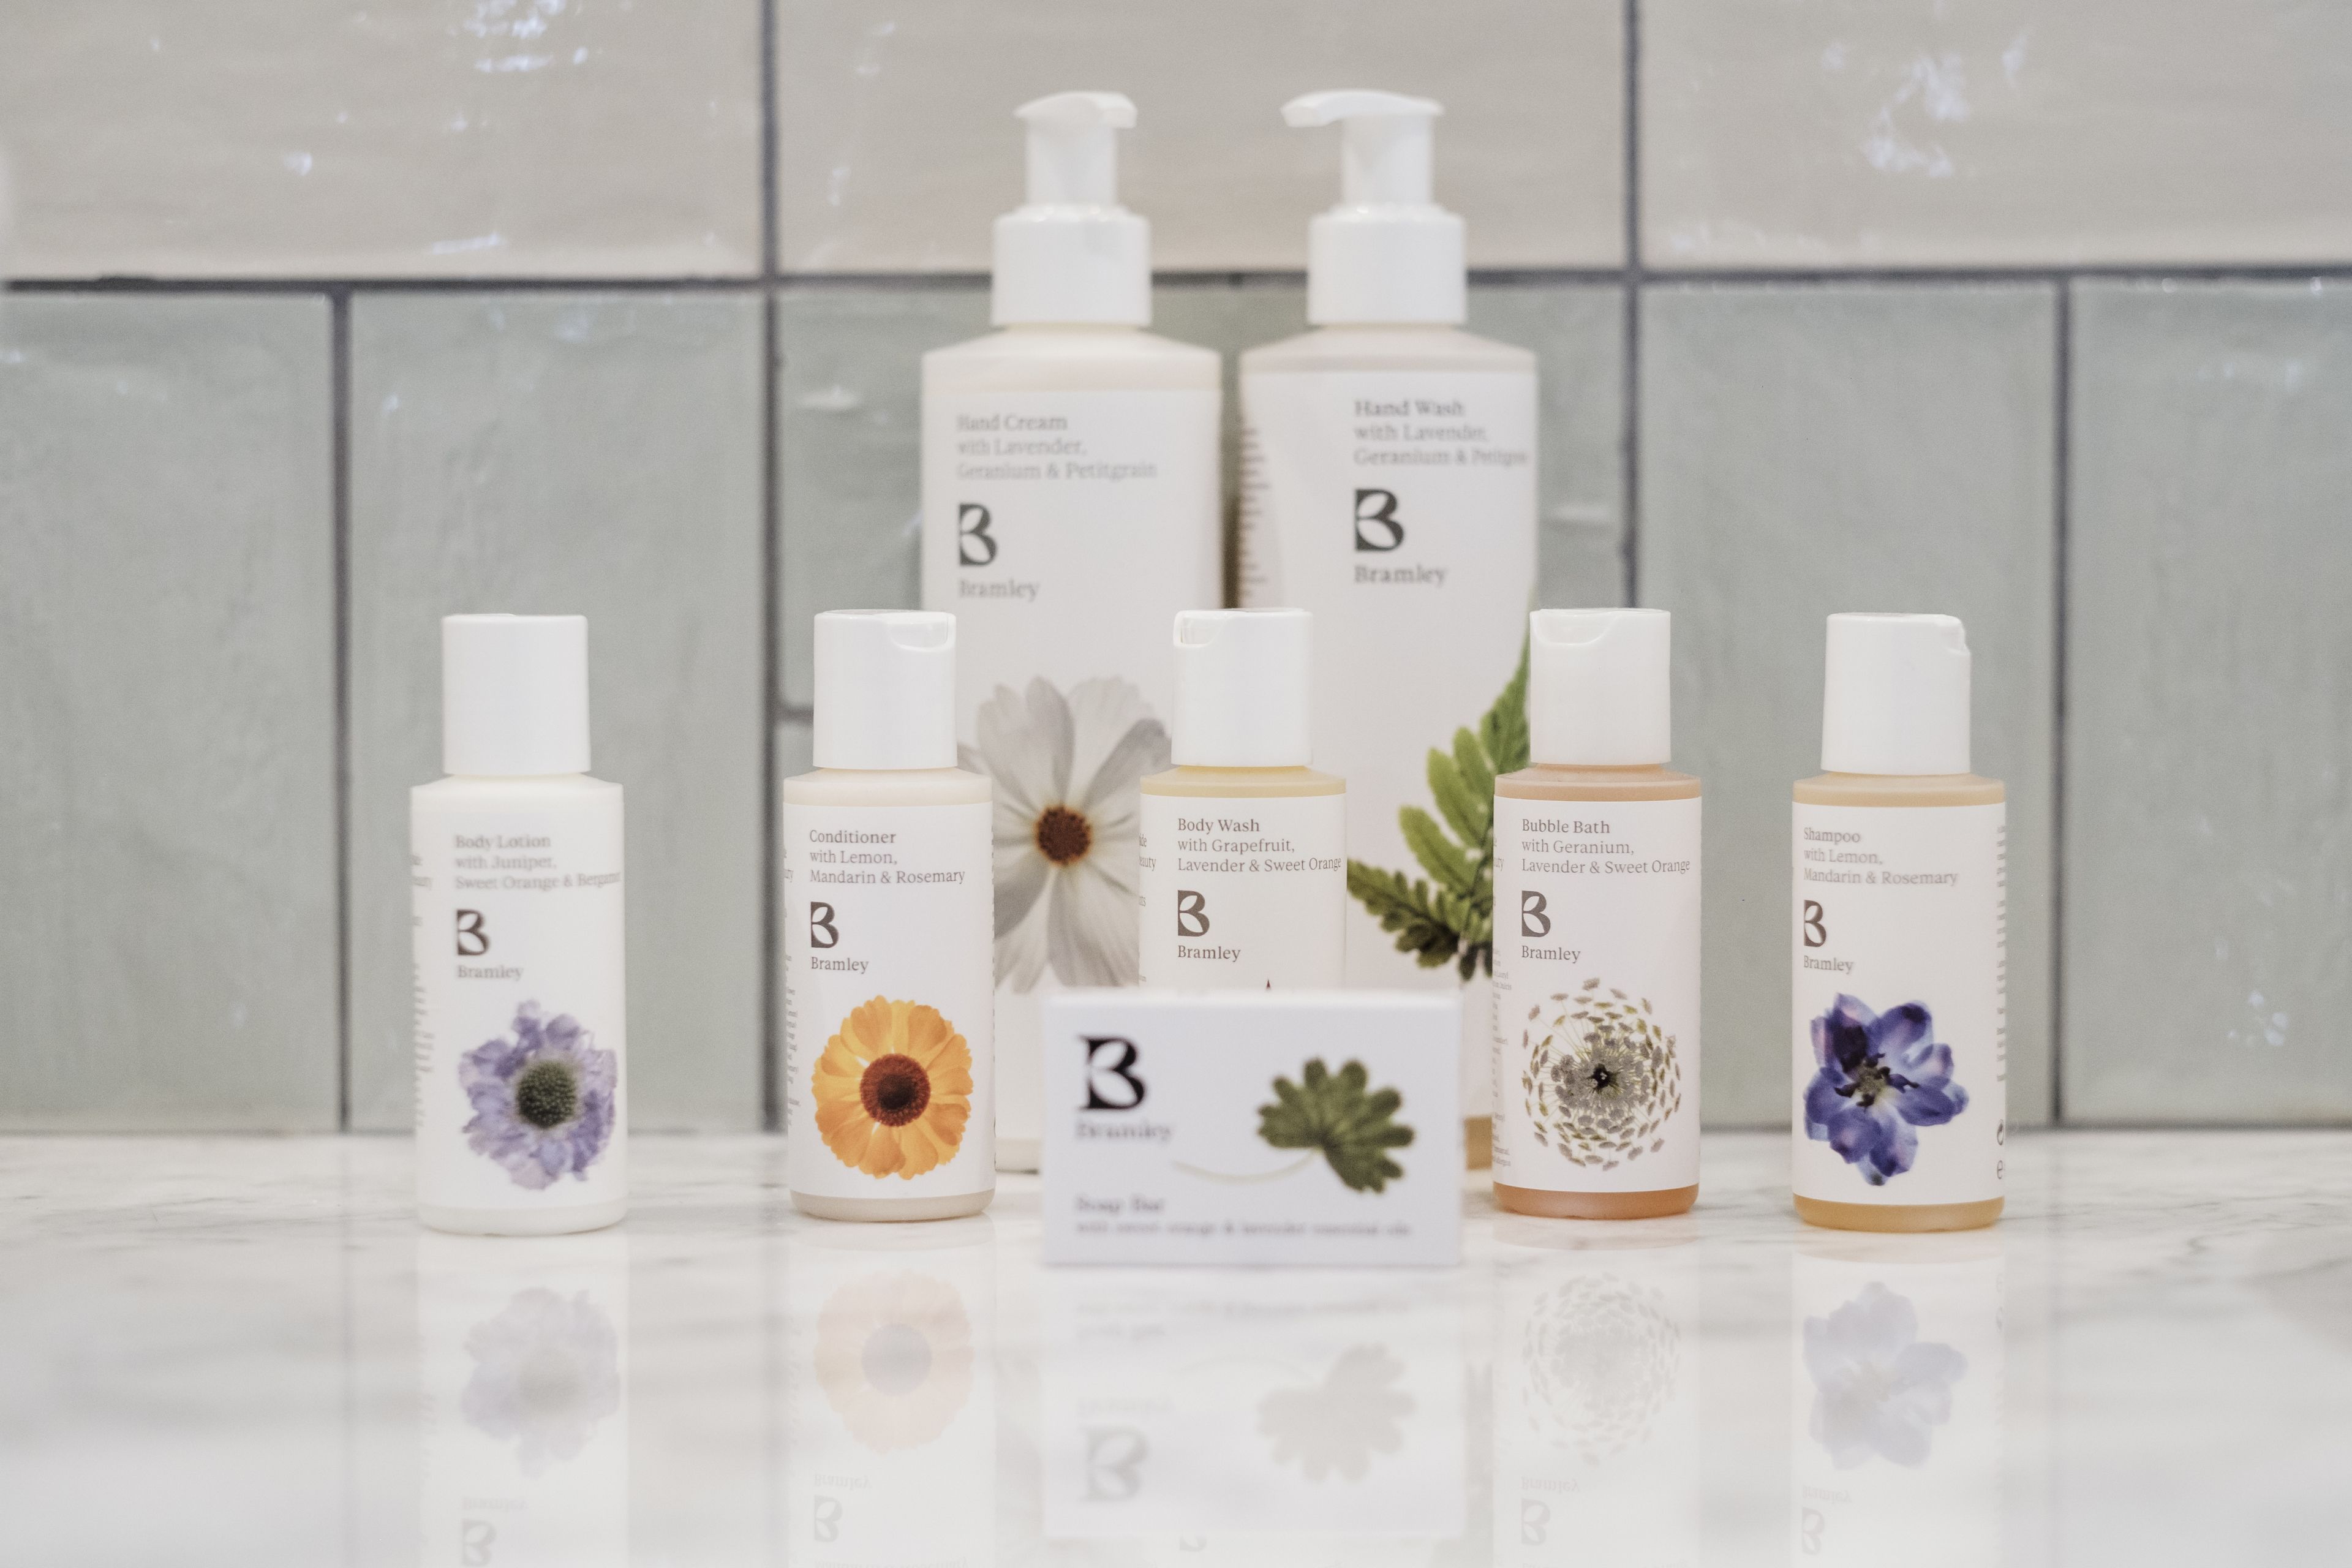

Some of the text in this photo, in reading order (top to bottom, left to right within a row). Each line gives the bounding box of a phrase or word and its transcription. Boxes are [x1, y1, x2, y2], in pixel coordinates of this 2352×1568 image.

[1354, 400, 1464, 417] Hand Wash
[956, 414, 1068, 432] Hand Cream
[1354, 424, 1398, 441] with
[957, 439, 990, 455] with
[1353, 448, 1452, 466] Geranium
[956, 461, 1157, 483] Geranium & Petitgrain
[1354, 565, 1446, 588] Bramley
[958, 578, 1039, 601] Bramley
[1178, 818, 1259, 835] Body Wash
[1523, 819, 1610, 834] Bubble Bath
[454, 834, 551, 851] Body Lotion
[809, 830, 896, 843] Conditioner
[1804, 827, 1861, 845] Shampoo
[1178, 839, 1294, 855] with Grapefruit,
[1521, 839, 1634, 855] with Geranium,
[454, 855, 556, 871] with Juniper,
[810, 850, 897, 865] with Lemon,
[1178, 858, 1341, 872] Lavender & Sweet Orange
[1804, 848, 1883, 865] with Lemon,
[1522, 858, 1690, 875] Lavender & Sweet Orange
[454, 876, 497, 889] Sweet
[501, 875, 560, 892] Orange
[563, 875, 573, 888] &
[810, 870, 876, 884] Mandarin
[880, 871, 891, 884] &
[896, 870, 965, 884] Rosemary
[1804, 867, 1958, 887] Mandarin & Rosemary
[1178, 945, 1241, 963] Bramley
[1521, 945, 1581, 964] Bramley
[456, 964, 523, 981] Bramley
[811, 956, 869, 974] Bramley
[1804, 955, 1854, 975] Bramley
